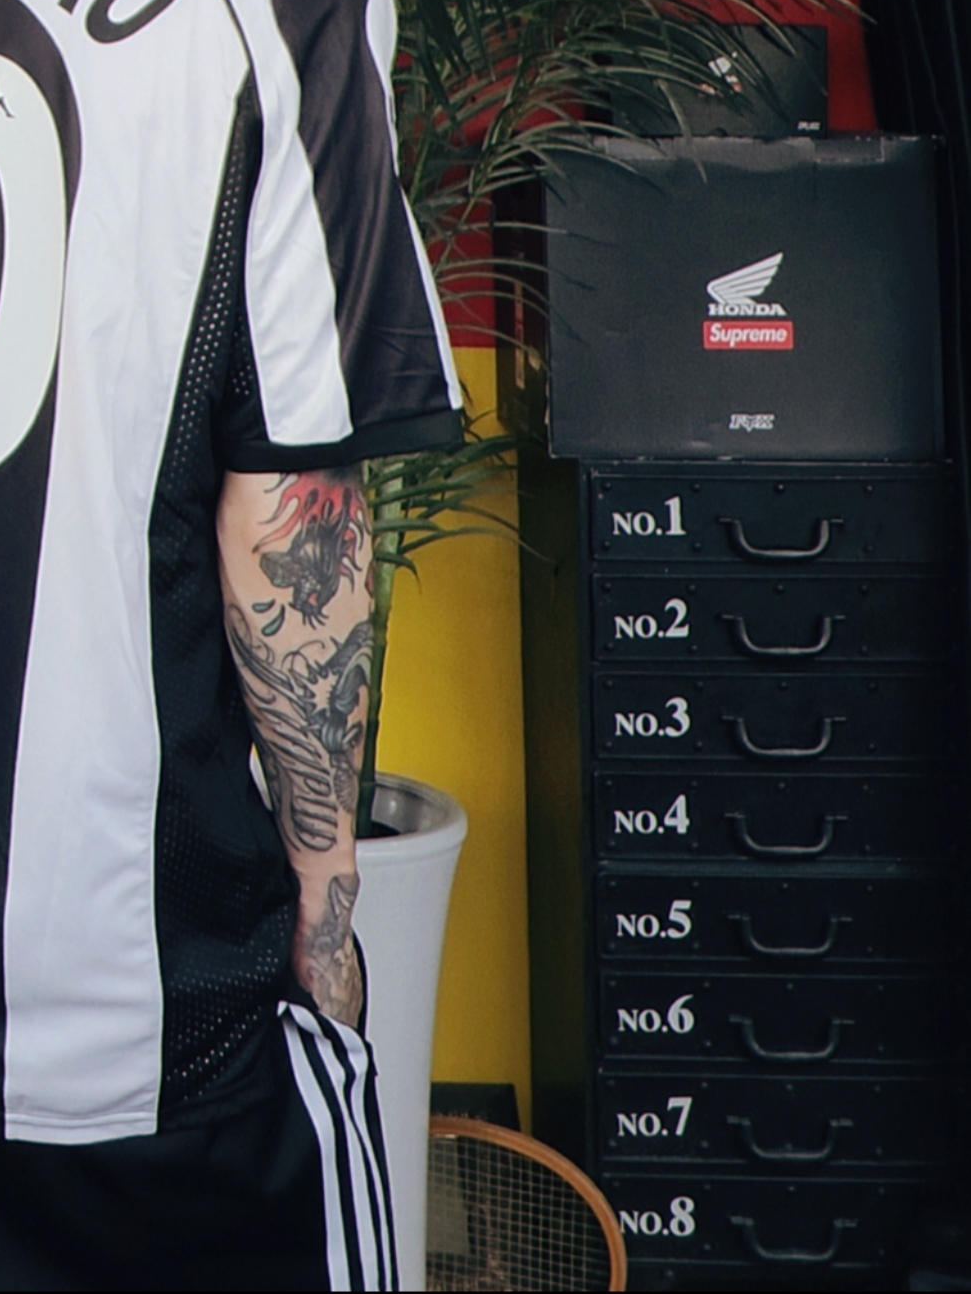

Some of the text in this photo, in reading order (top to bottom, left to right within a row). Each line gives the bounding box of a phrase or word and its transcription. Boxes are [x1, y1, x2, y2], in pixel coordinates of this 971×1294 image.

[708, 303, 787, 316] HONDA
[709, 323, 788, 348] Supreme
[612, 496, 686, 535] NO.1
[614, 598, 690, 638] NO.2
[614, 697, 691, 737] NO.3
[614, 794, 690, 834] NO.4
[616, 900, 692, 939] NO.5
[617, 994, 694, 1033] NO.6
[617, 1097, 693, 1136] NO.7
[619, 1196, 695, 1236] NO.8
